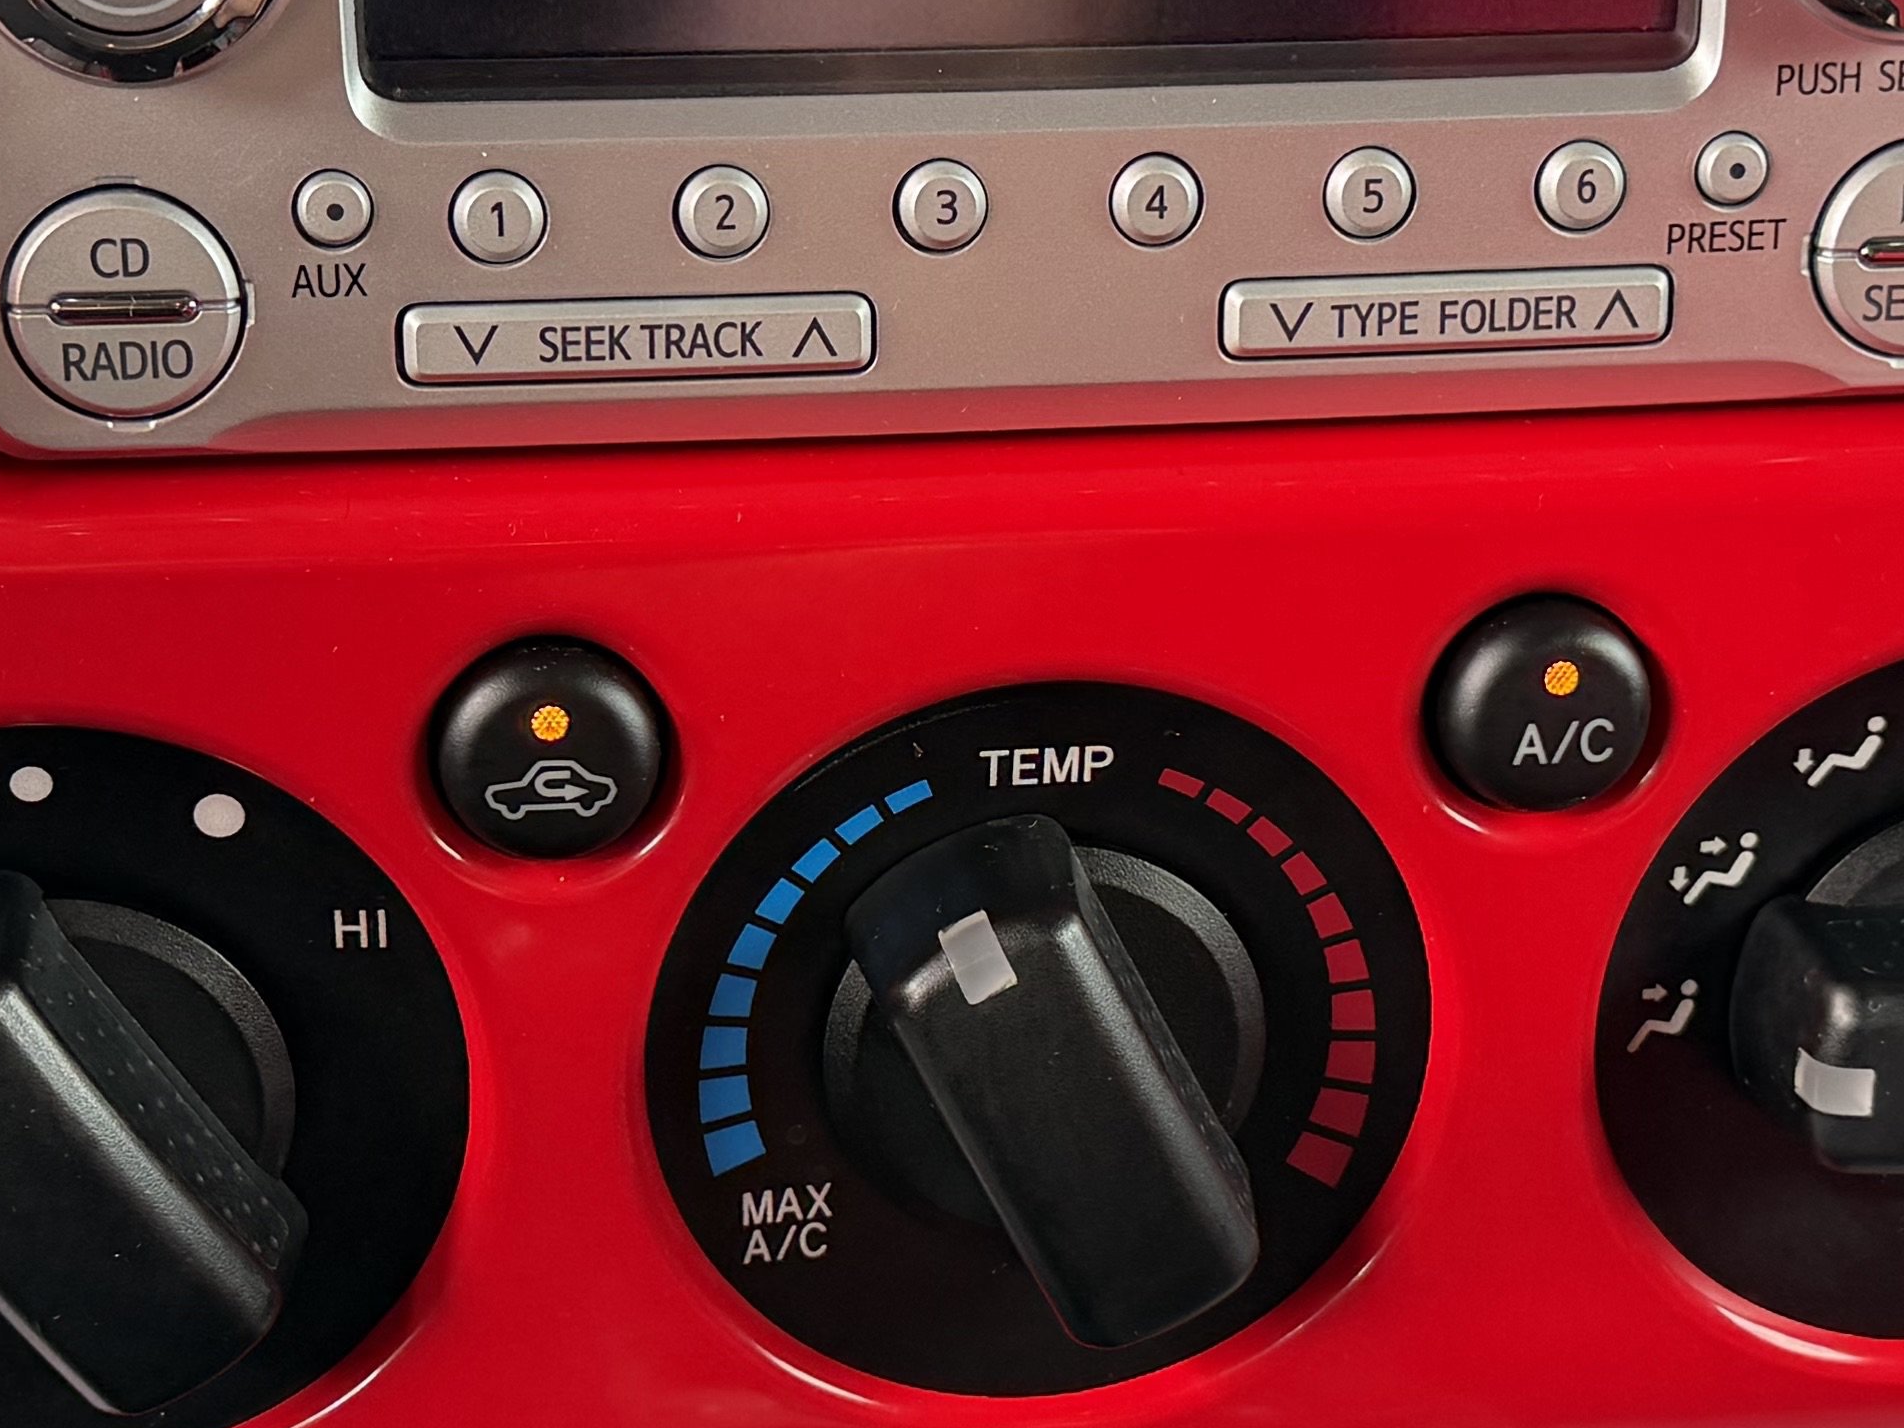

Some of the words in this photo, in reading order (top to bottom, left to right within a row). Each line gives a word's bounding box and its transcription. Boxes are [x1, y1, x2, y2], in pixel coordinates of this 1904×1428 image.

[1776, 61, 1862, 97] PUSH
[1145, 184, 1168, 220] 4
[1362, 178, 1384, 214] 5
[1577, 168, 1597, 204] 6
[490, 201, 505, 238] 1
[715, 194, 737, 231] 2
[936, 189, 958, 226] 3
[1666, 218, 1788, 255] PRESET
[89, 237, 150, 279] CD
[291, 262, 368, 299] AUX
[1330, 300, 1420, 339] TYPE
[1439, 294, 1577, 335] FOLDER
[61, 339, 194, 382] RADIO
[539, 324, 632, 363] SEEK
[639, 320, 764, 360] TRACK
[1512, 718, 1615, 766] A/C
[979, 745, 1114, 787] TEMP
[333, 908, 387, 949] HI
[742, 1182, 833, 1227] MAX
[742, 1221, 829, 1265] A/C
